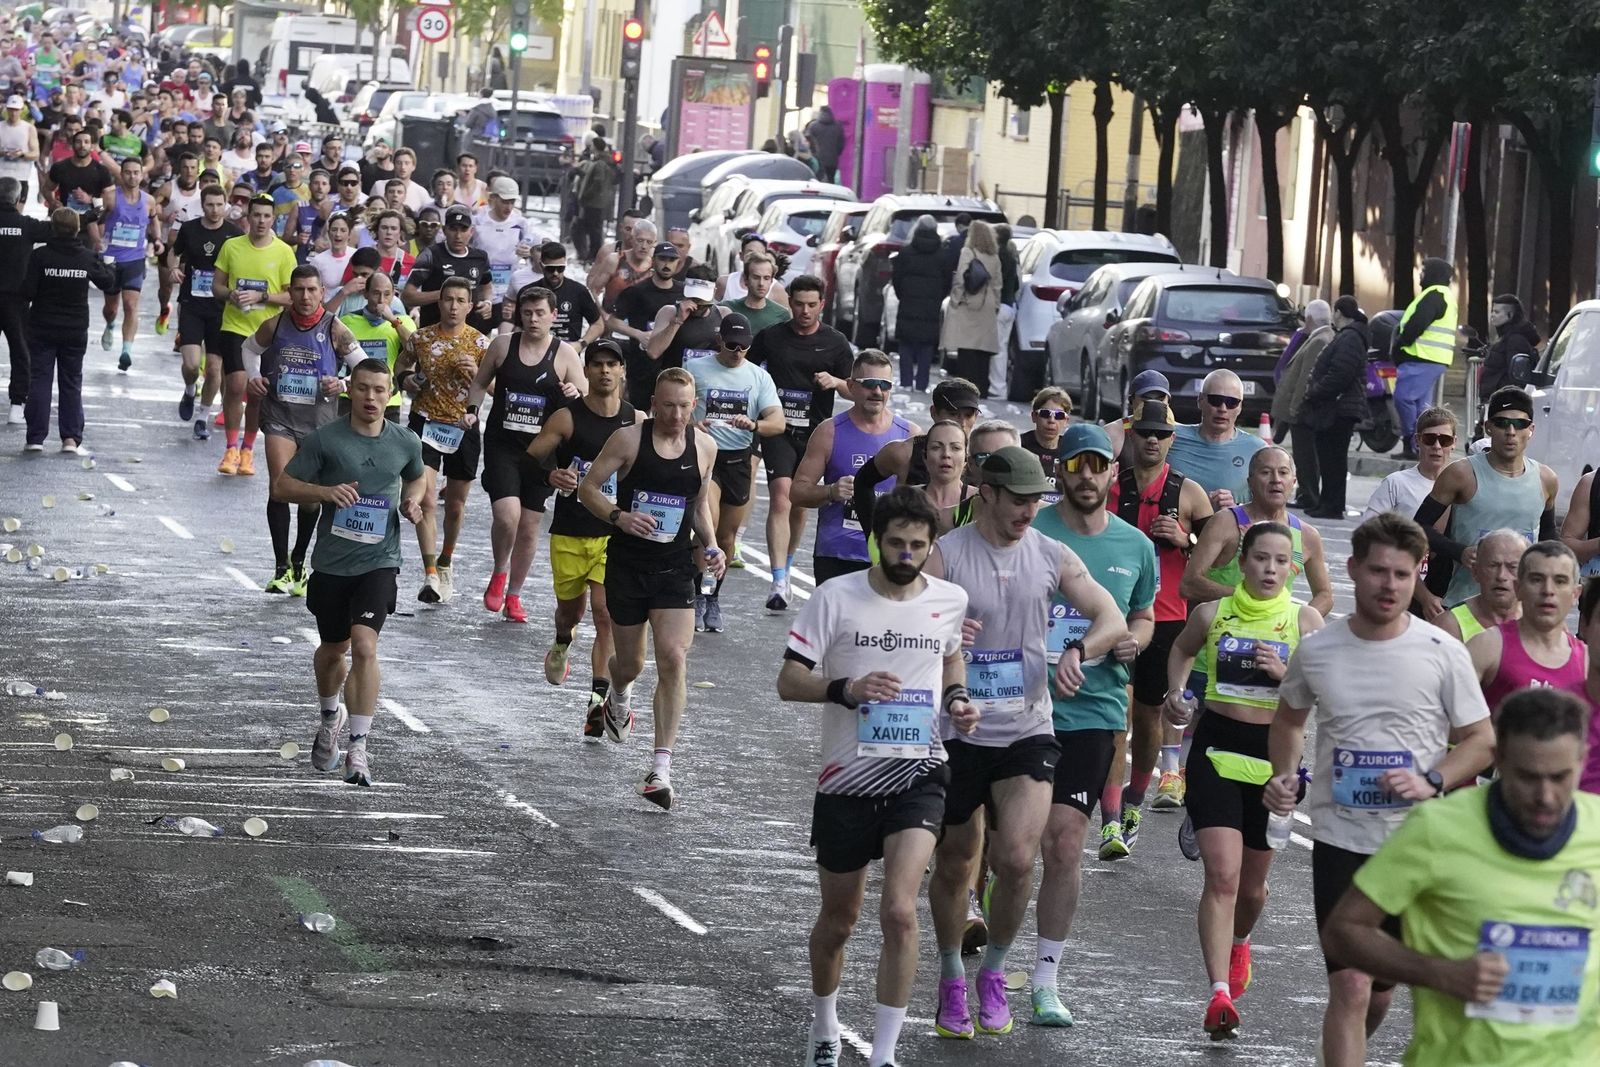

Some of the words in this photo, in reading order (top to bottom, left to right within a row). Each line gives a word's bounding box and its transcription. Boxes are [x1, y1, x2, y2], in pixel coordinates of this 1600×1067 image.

[424, 19, 444, 31] 30
[45, 268, 88, 279] VOLUNTEER
[290, 367, 314, 376] ZURICH
[279, 384, 313, 396] DESIUNAI
[721, 391, 745, 399] ZURICH
[785, 391, 808, 399] ZURICH
[518, 395, 542, 404] ZURICH
[506, 412, 540, 425] ANDREW
[426, 430, 457, 446] PAQUITO
[357, 497, 385, 507] ZURICH
[650, 494, 680, 506] ZURICH
[345, 517, 374, 532] COLIN
[977, 652, 1015, 662] ZURICH
[997, 686, 1024, 697] OWEN
[887, 713, 909, 723] 7874
[872, 726, 920, 741] XAVIER
[1358, 755, 1404, 766] ZURICH
[1352, 790, 1392, 805] KOEN
[1520, 929, 1580, 947] ZURICH
